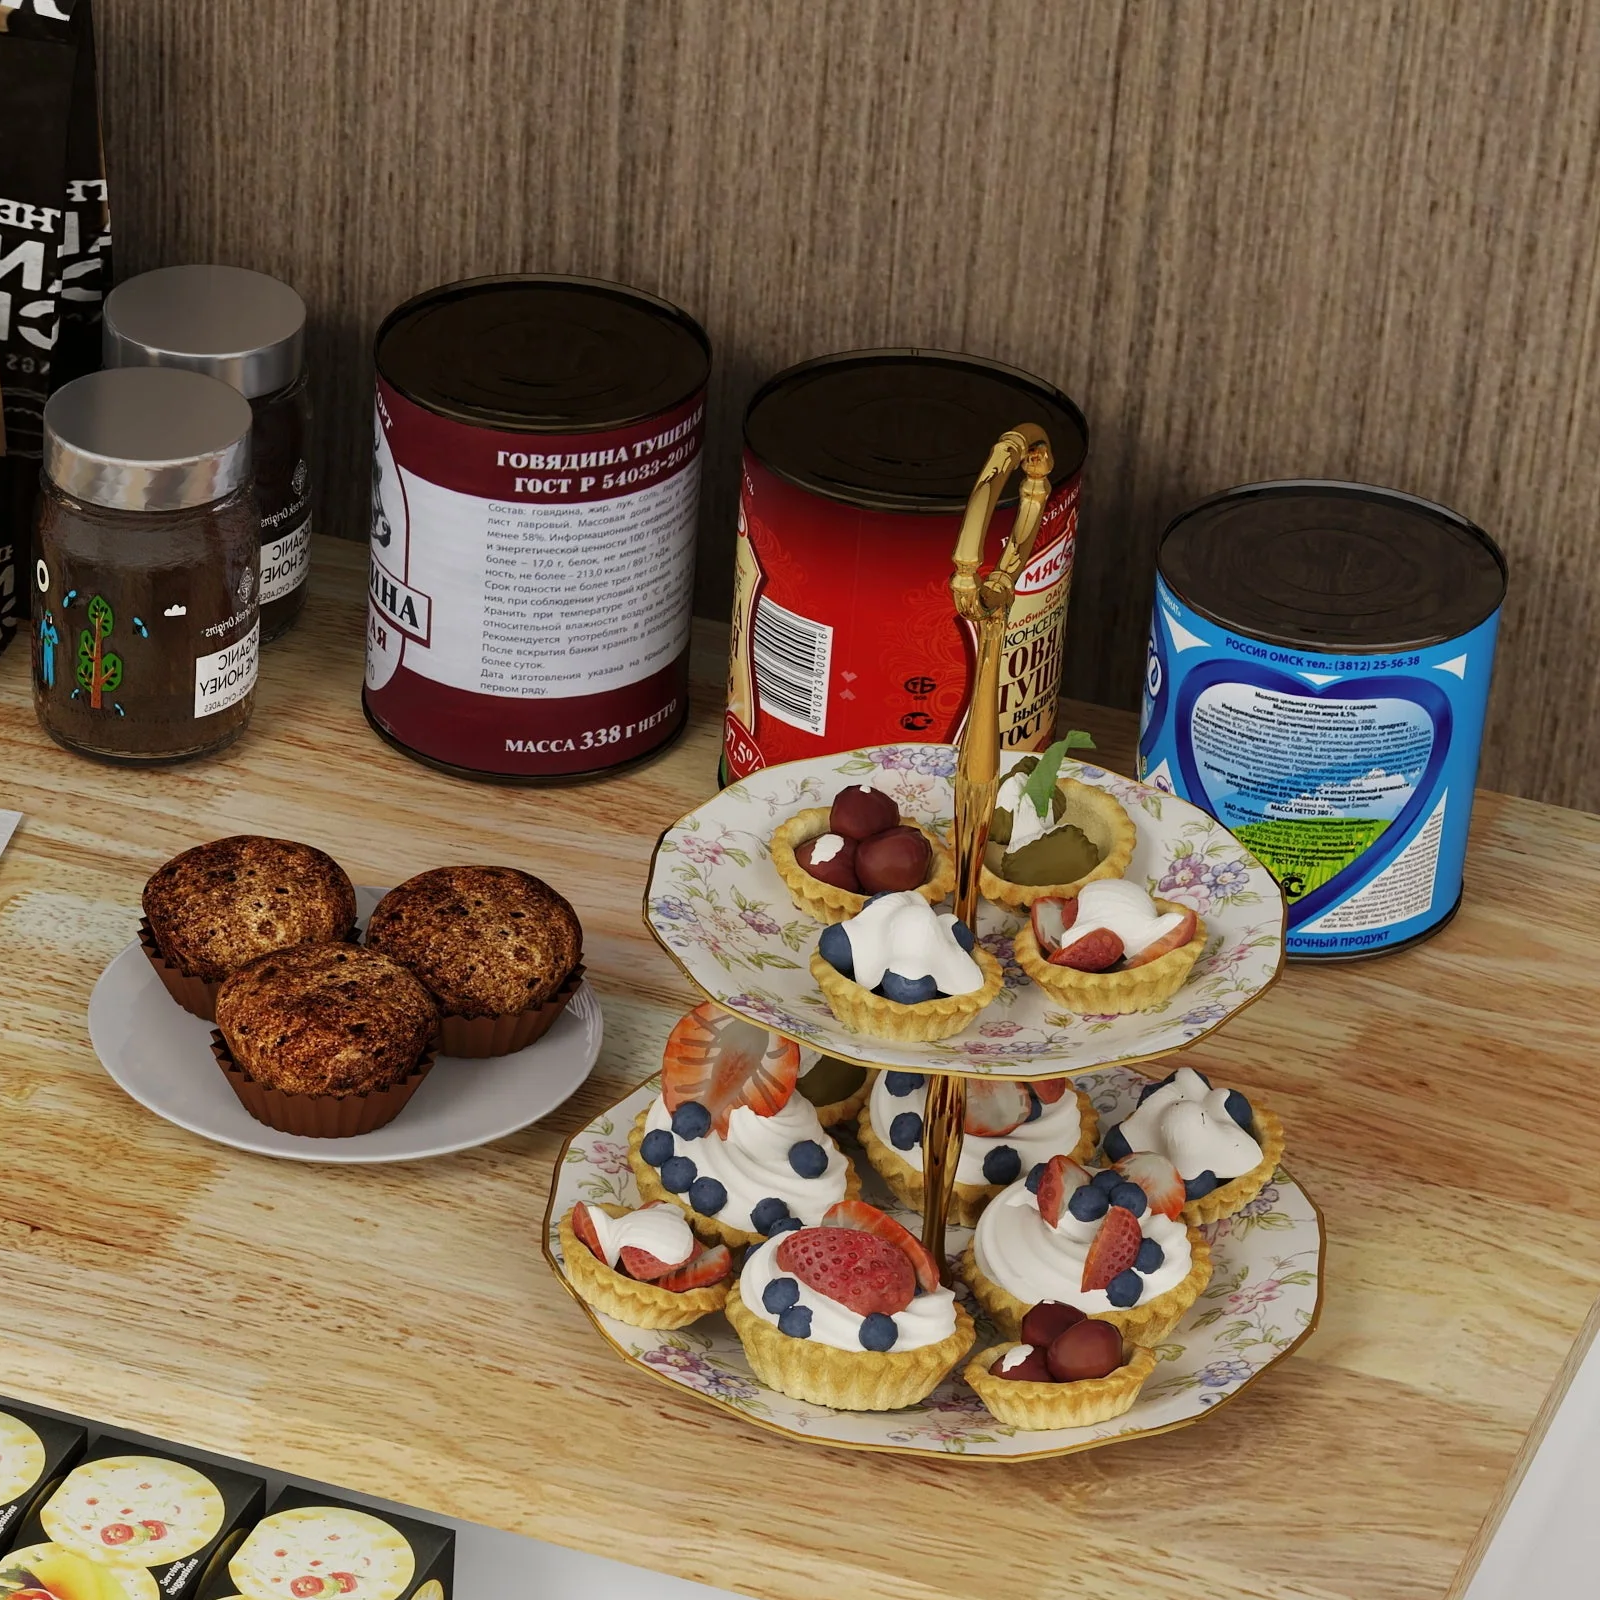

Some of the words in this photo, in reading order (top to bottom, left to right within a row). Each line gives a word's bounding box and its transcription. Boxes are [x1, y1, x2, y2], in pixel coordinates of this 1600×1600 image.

[497, 446, 629, 472] ГОВЯДИНА
[632, 404, 703, 458] ТУШЕНАЯ
[514, 477, 572, 494] ГОСТ
[602, 436, 696, 490] 54033-2010
[488, 503, 527, 515] Состав:
[532, 508, 583, 517] говядина,
[578, 514, 626, 527] Массовая
[550, 523, 638, 542] Информационные
[496, 544, 578, 555] энергетической
[581, 539, 627, 553] ценности
[484, 580, 510, 592] Срок
[513, 584, 562, 594] годности
[530, 595, 594, 607] соблюдении
[596, 585, 635, 604] условий
[484, 606, 527, 618] Хранить
[560, 603, 623, 619] температуре
[483, 619, 562, 631] относительной
[565, 616, 619, 631] влажности
[482, 630, 560, 645] Рекомендуется
[567, 625, 628, 644] употреблять
[482, 643, 513, 656] После
[516, 647, 566, 658] вскрытия
[569, 643, 599, 656] банки
[601, 635, 639, 650] хранить
[1225, 637, 1267, 659] РОССИЯ
[1269, 652, 1304, 667] ОМСК
[1306, 659, 1333, 670] тел.:
[1334, 660, 1370, 672] (3812)
[1372, 655, 1421, 670] 25-56-38
[481, 656, 512, 669] более
[513, 659, 545, 670] суток.
[480, 669, 504, 681] Дата
[510, 671, 582, 683] изготовления
[587, 663, 624, 680] указана
[480, 681, 519, 694] первом
[521, 685, 549, 696] ряду.
[505, 738, 575, 753] МАССА
[579, 724, 621, 750] 338
[638, 698, 677, 733] НЕТТО
[1270, 803, 1293, 814] МАССА
[1294, 807, 1316, 816] НЕТТО
[1340, 930, 1390, 947] ПРОДУКТ
[160, 1561, 186, 1586] Serving
[166, 1558, 199, 1595] Suggestions
